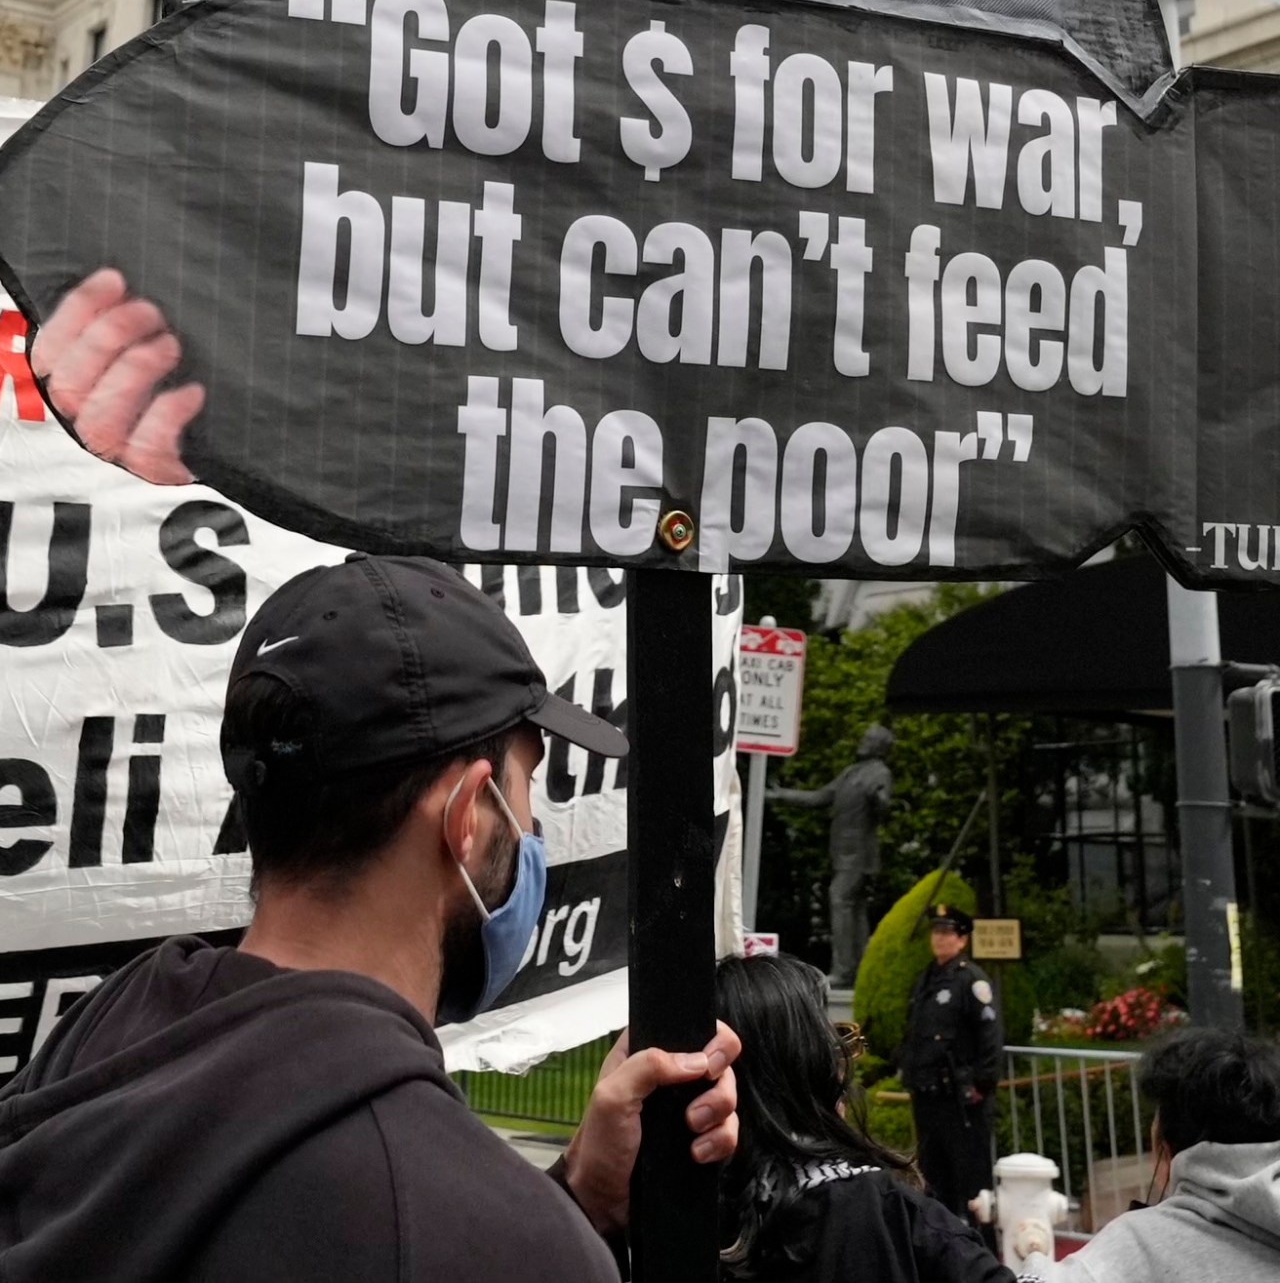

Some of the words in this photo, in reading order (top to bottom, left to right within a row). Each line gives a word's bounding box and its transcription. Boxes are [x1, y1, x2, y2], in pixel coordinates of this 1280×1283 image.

[620, 19, 694, 182] $
[730, 24, 894, 194] for
[924, 71, 1143, 247] war,
[295, 161, 522, 351] but
[559, 210, 873, 377] can’t
[904, 223, 1128, 397] feed
[457, 375, 664, 556] the
[699, 410, 1034, 574] poor”
[741, 656, 762, 668] AXI
[767, 658, 795, 672] CAB
[741, 670, 785, 688] ONLY
[760, 695, 785, 710] ALL
[740, 712, 779, 728] TIMES
